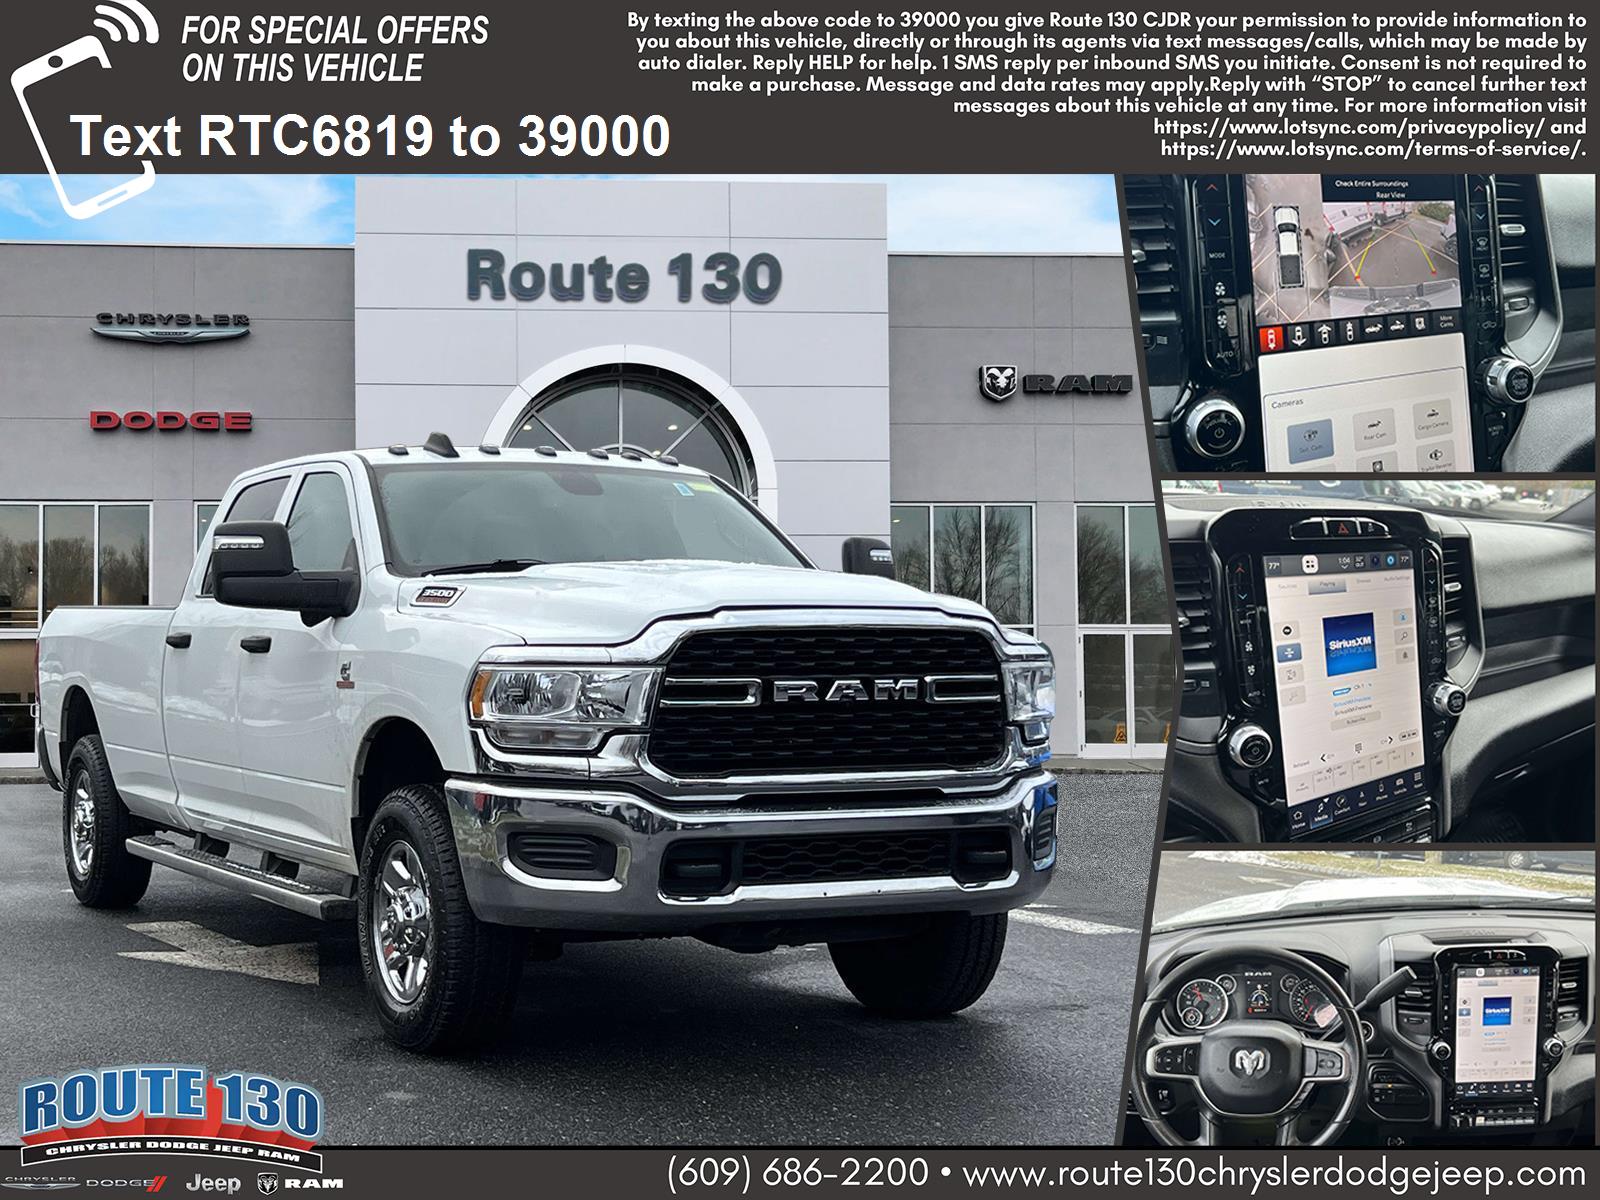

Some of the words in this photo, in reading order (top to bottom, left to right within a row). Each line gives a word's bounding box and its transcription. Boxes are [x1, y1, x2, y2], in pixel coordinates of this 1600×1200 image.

[1372, 180, 1408, 188] Surroundings
[467, 248, 650, 302] Route
[667, 252, 782, 304] 130
[96, 312, 250, 326] CHRYSLER
[1217, 350, 1234, 358] AUTO
[1023, 374, 1133, 394] RAM
[1271, 398, 1304, 410] Cameras
[89, 411, 252, 431] DODGE
[422, 589, 455, 598] 3500
[1329, 636, 1371, 650] SiriusXM
[773, 679, 919, 702] RAM
